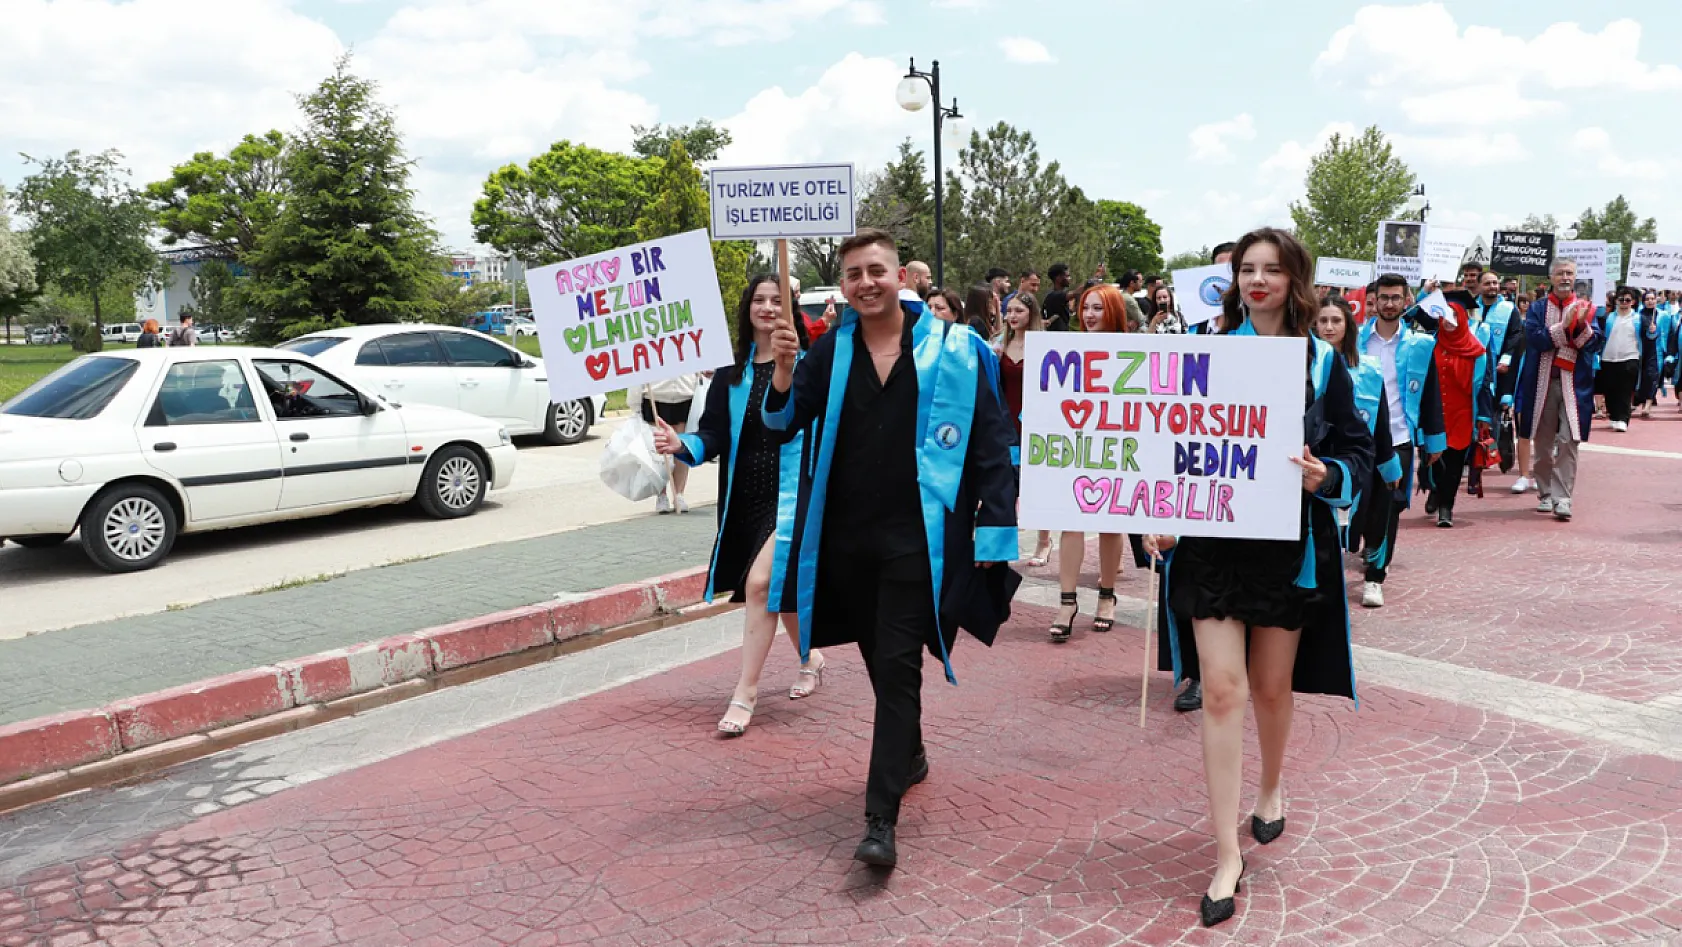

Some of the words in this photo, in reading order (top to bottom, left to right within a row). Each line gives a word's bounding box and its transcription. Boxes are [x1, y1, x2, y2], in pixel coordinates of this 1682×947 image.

[717, 179, 775, 198] TURİZM
[778, 180, 800, 197] VE
[804, 179, 847, 196] OTEL
[726, 201, 840, 227] İŞLETMECİLİĞİ
[576, 276, 662, 321] MEZUN
[1039, 349, 1210, 397] MEZUN
[1028, 431, 1141, 472] DEDİLER
[1174, 439, 1258, 480] DEDİM
